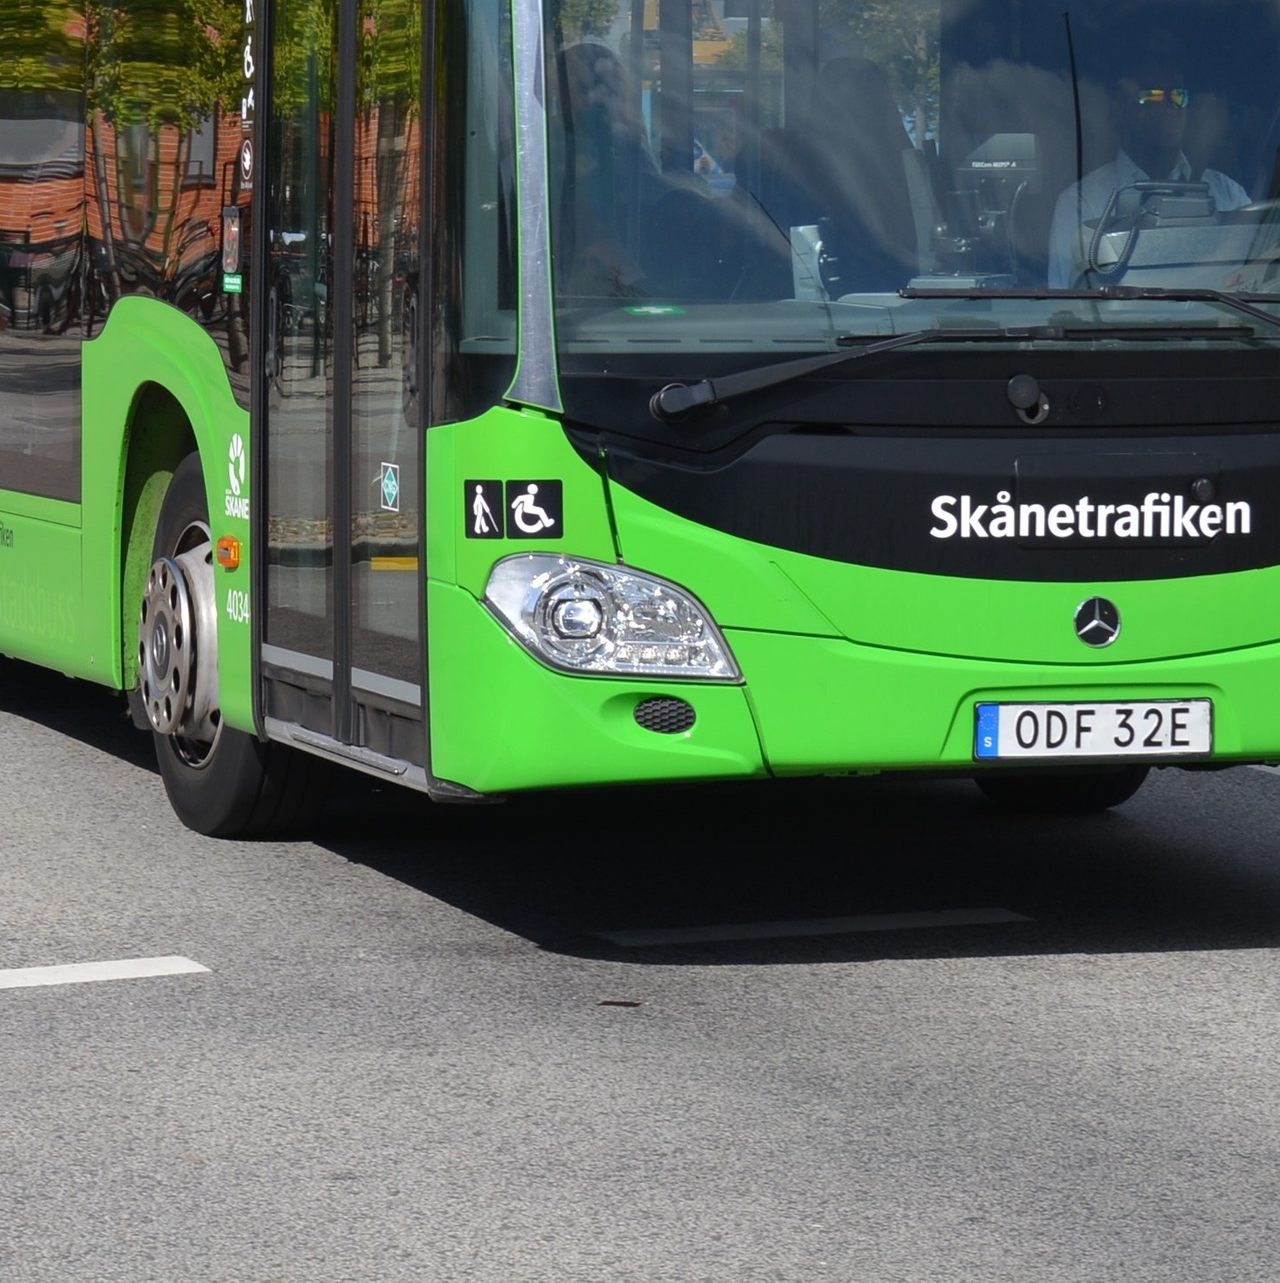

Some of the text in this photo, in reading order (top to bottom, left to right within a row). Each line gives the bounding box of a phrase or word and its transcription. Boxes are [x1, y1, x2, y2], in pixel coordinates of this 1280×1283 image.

[929, 490, 1251, 539] Skånetrafiken
[226, 588, 250, 624] 4034
[983, 735, 993, 748] S
[1015, 707, 1191, 749] ODF 32E
